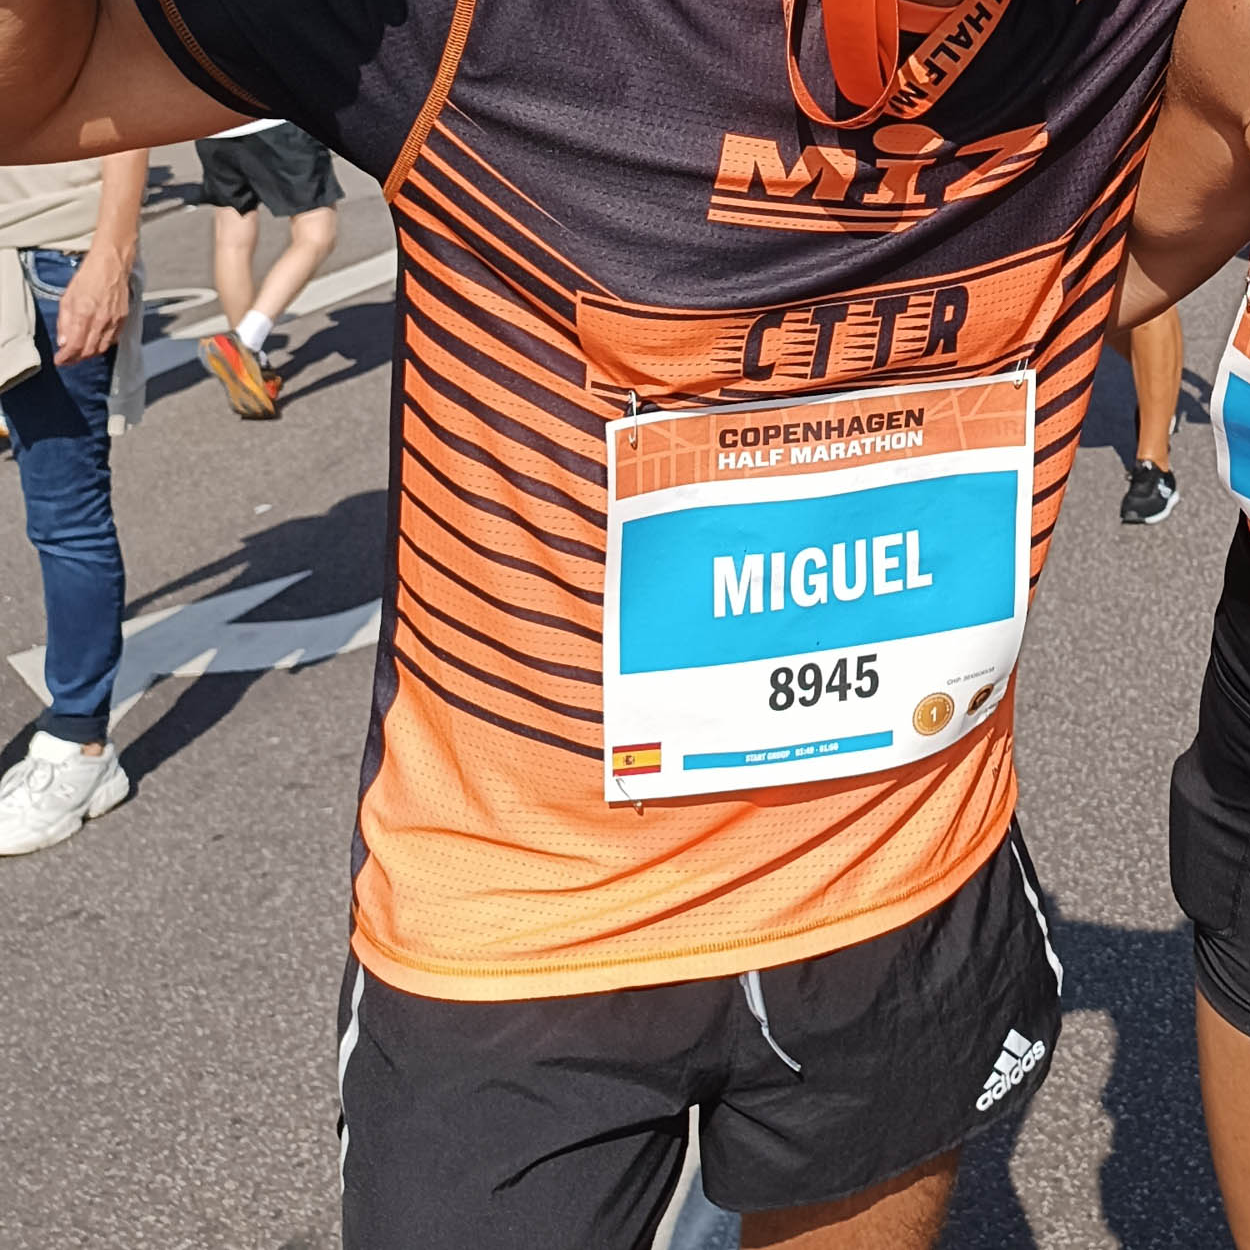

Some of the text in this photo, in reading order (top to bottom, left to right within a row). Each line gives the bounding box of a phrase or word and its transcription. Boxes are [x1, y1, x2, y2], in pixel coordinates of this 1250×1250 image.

[924, 0, 994, 87] HALF
[742, 285, 969, 382] CTTR
[717, 430, 925, 471] HALF MARATHON
[718, 407, 925, 449] COPENHAGEN
[712, 529, 934, 620] MIGUEL
[768, 653, 881, 713] 8945
[930, 707, 938, 723] 1
[767, 750, 791, 761] GROUP
[976, 1040, 1046, 1112] adidas
